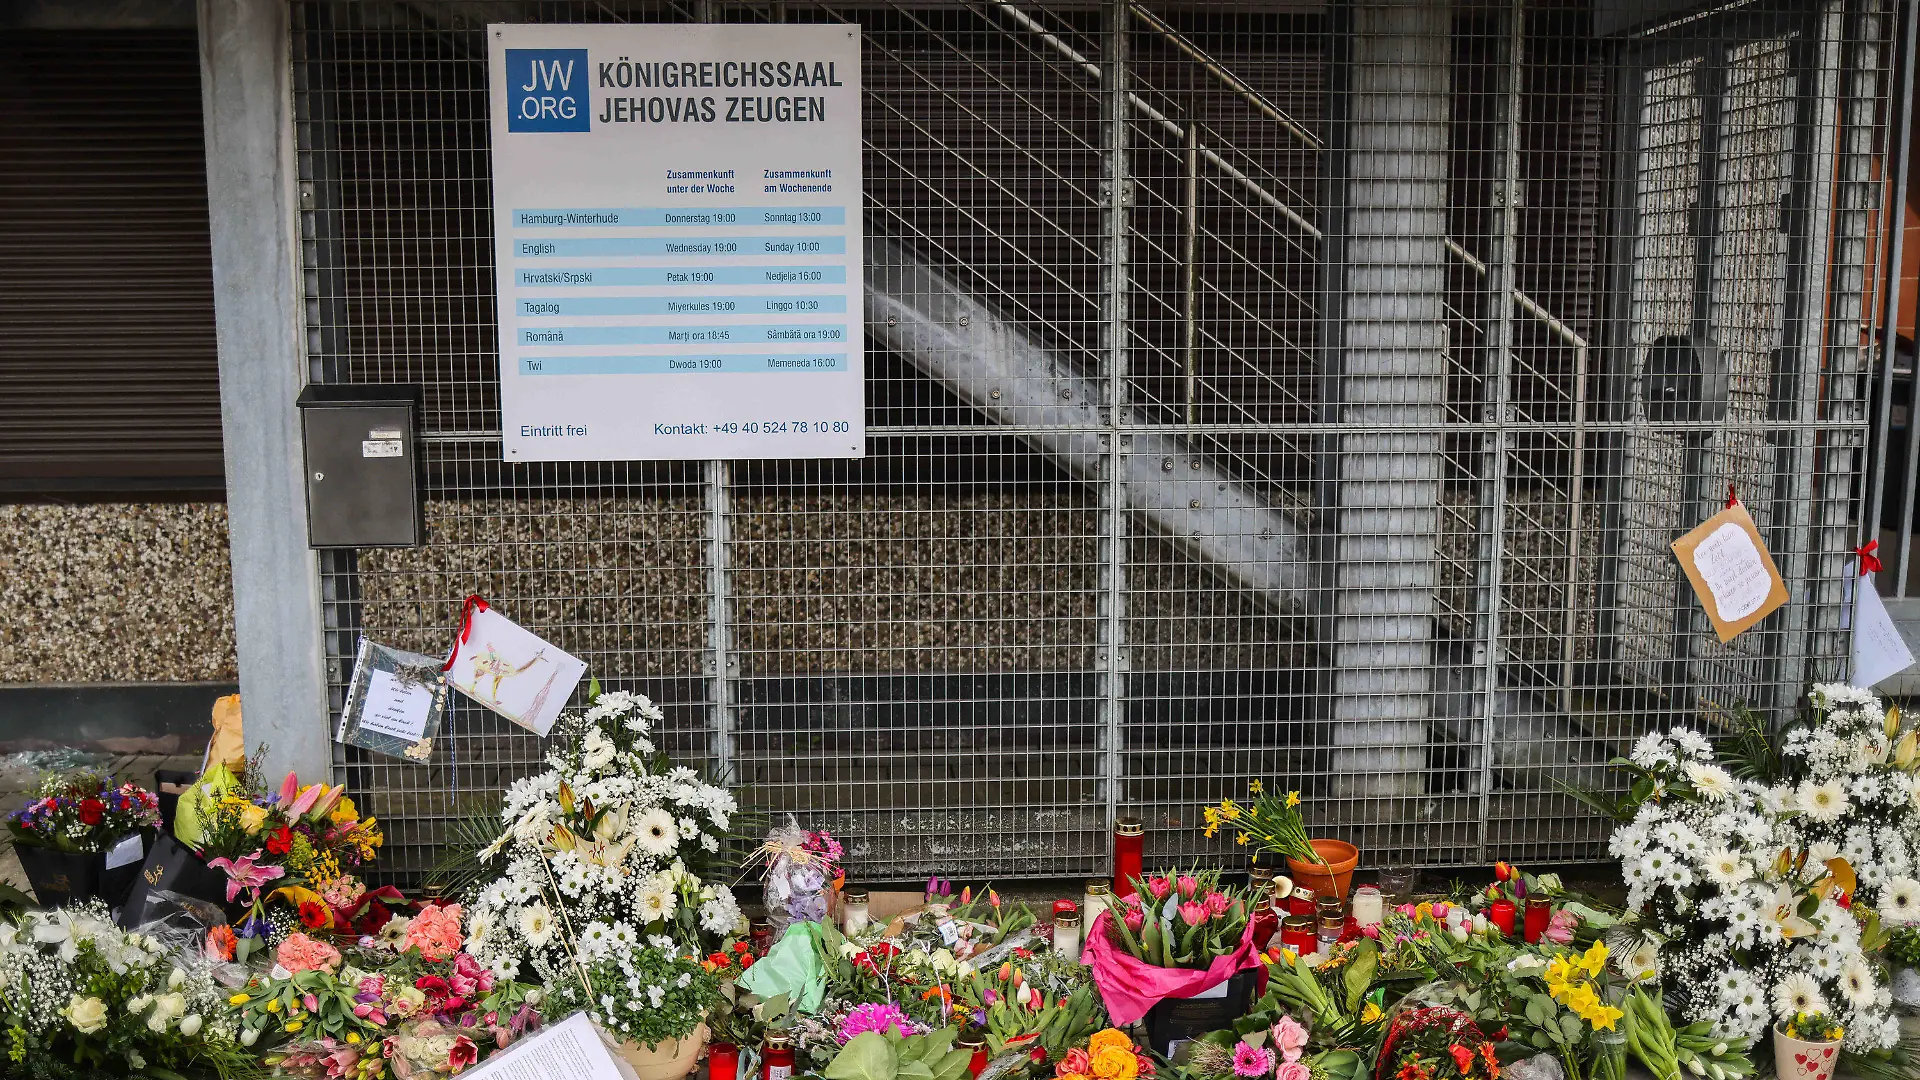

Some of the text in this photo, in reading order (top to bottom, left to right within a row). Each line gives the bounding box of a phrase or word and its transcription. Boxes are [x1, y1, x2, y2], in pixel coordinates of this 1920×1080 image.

[521, 59, 574, 92] JW
[598, 56, 843, 89] KÖNIGREICHSSAAL
[517, 96, 577, 120] .ORG
[599, 96, 825, 124] JEHOVAS ZEUGEN
[666, 169, 735, 179] Zusammenkunft
[763, 168, 832, 179] Zusammenkunft
[666, 183, 735, 194] unter der Woche
[764, 183, 832, 194] am Wochenende
[521, 212, 619, 226] Hamburg-Winterhude
[665, 213, 736, 225] Donnerstag 19:00
[764, 212, 822, 224] Sonntag 13:00
[522, 242, 556, 256] English
[665, 242, 737, 254] Wednesday 19:00
[764, 241, 820, 254] Sunday 10:00
[523, 272, 593, 286] Hrvatski/Srpski
[667, 272, 714, 283] Petak 19:00
[765, 271, 822, 283] Nedjelja 16:00
[523, 302, 560, 315] Tagalog
[667, 301, 736, 313] Miyerkules 19:00
[766, 300, 819, 312] Linggo 10:30
[525, 330, 564, 342] Română
[692, 332, 705, 341] ora
[707, 330, 730, 340] 18:45
[803, 330, 817, 339] ora
[818, 329, 841, 339] 19:00
[526, 360, 542, 372] Twi
[669, 359, 722, 369] Dwoda 19:00
[767, 358, 836, 368] Memeneda 16:00
[520, 424, 588, 437] Eintritt frei
[654, 420, 849, 435] Kontakt: +49 40 524 78 10 80
